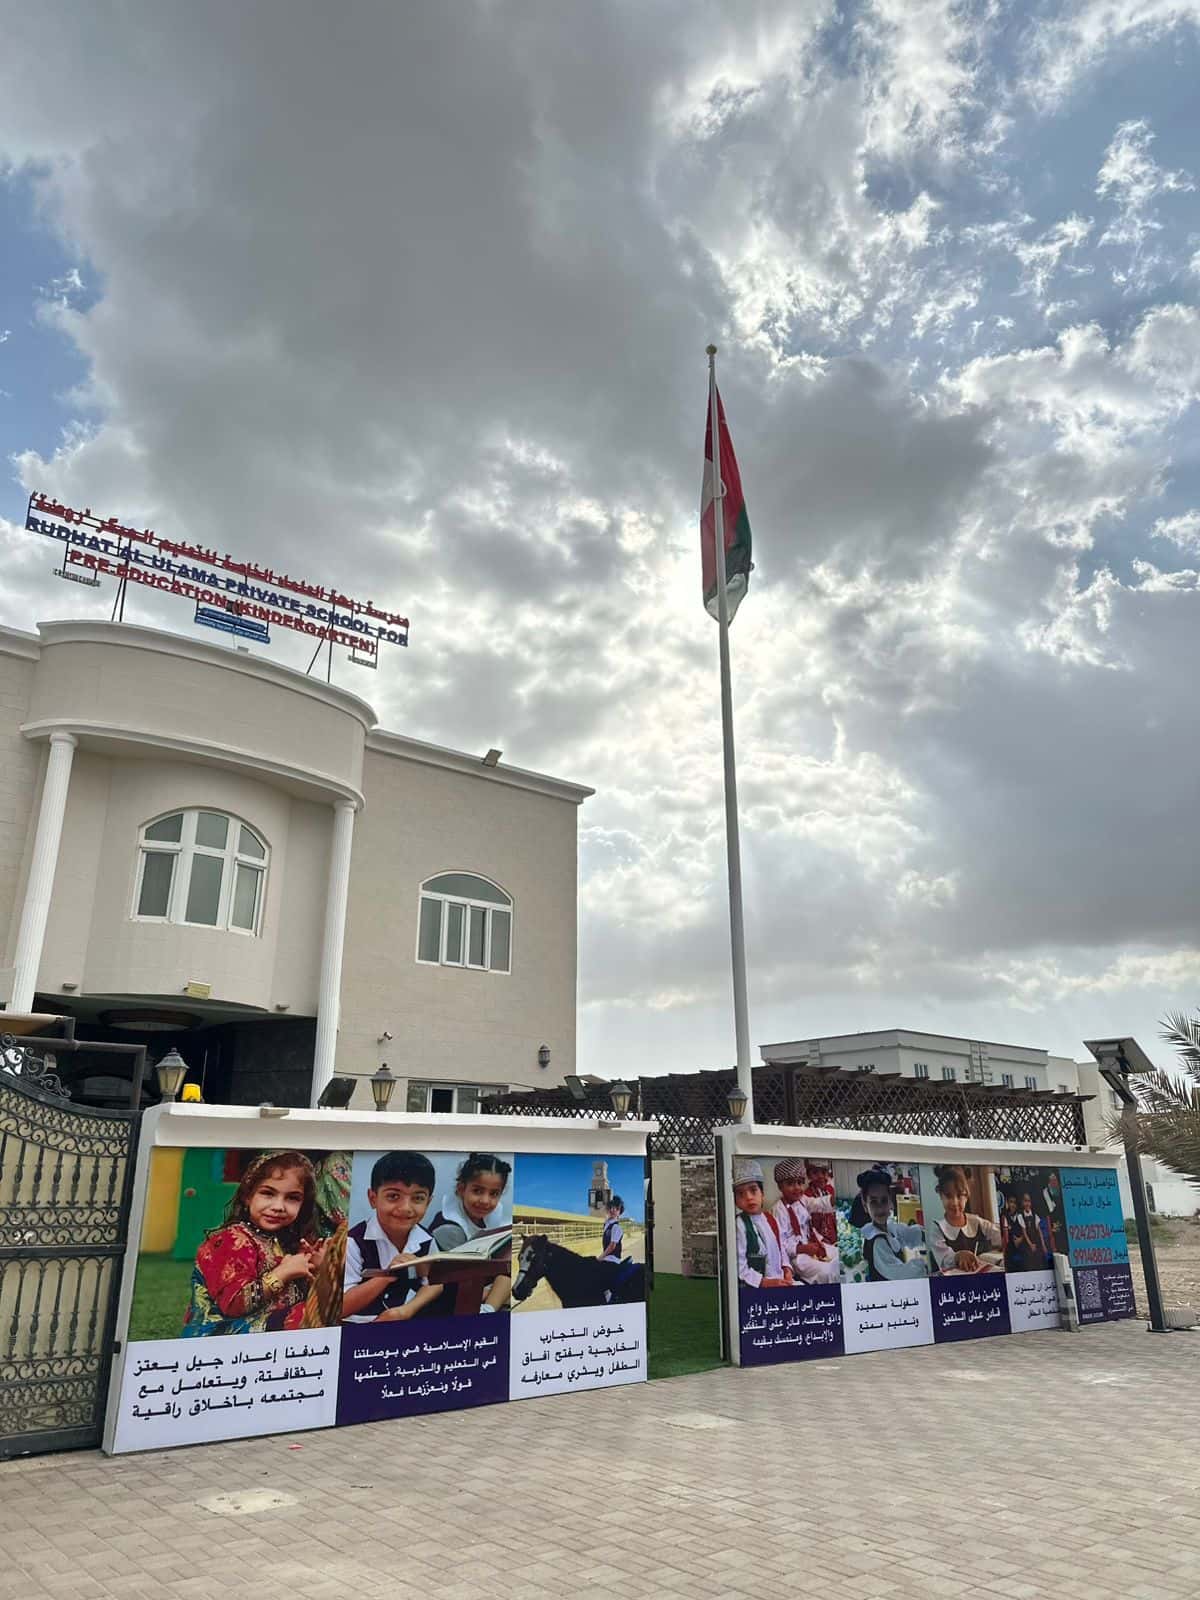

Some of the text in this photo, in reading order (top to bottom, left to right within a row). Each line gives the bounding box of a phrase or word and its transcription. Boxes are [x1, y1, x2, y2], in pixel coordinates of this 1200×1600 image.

[25, 516, 114, 553] RUDHAT
[120, 546, 145, 563] AL
[151, 556, 219, 587] ULAMA
[225, 578, 301, 612] PRIVATE
[305, 603, 375, 637] SCHOOL
[378, 626, 409, 647] FOR
[938, 1292, 954, 1306] طفل
[956, 1291, 967, 1304] كل
[982, 1288, 1001, 1301] نؤمن
[856, 1297, 919, 1312] طفولة سعيدة
[968, 1310, 984, 1323] على
[859, 1317, 919, 1333] وتعليم ممتع
[540, 1324, 625, 1344] خوض التجارب
[353, 1335, 499, 1360] القيم الإسلامية هي بوصلتنا
[555, 1347, 584, 1362] يفتح
[588, 1340, 640, 1358] الخارجية
[132, 1344, 330, 1376] هدفنا إعداد جيل يعتز
[444, 1357, 479, 1373] التعليم
[482, 1355, 497, 1369] في
[520, 1360, 640, 1384] الطفل ويثري معارفه
[138, 1383, 164, 1398] مع
[171, 1373, 248, 1395] ويتعامل
[131, 1388, 325, 1420] مجتمعه بأخلاق راقية
